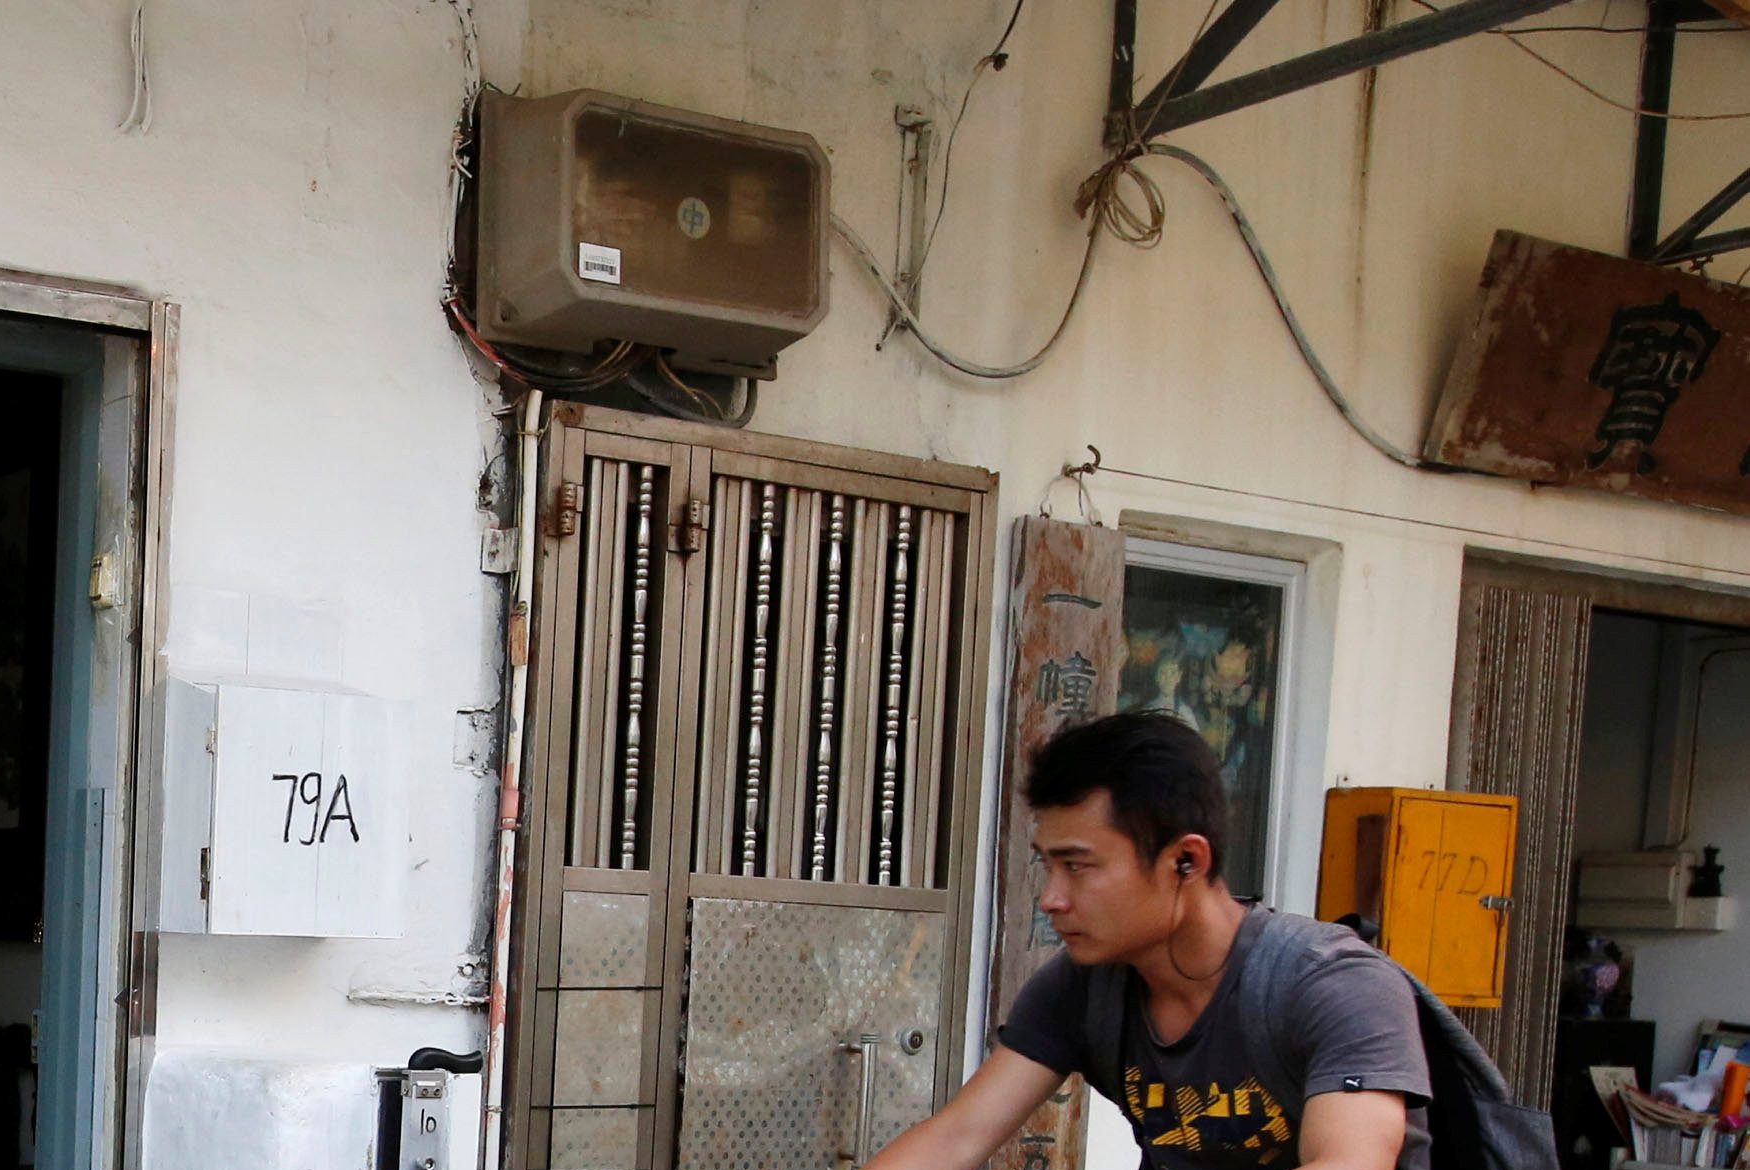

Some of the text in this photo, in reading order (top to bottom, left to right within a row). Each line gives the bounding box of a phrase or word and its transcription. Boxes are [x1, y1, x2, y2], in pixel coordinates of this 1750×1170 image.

[272, 772, 360, 846] 79A
[1418, 850, 1488, 895] 77D
[420, 1108, 437, 1136] 10
